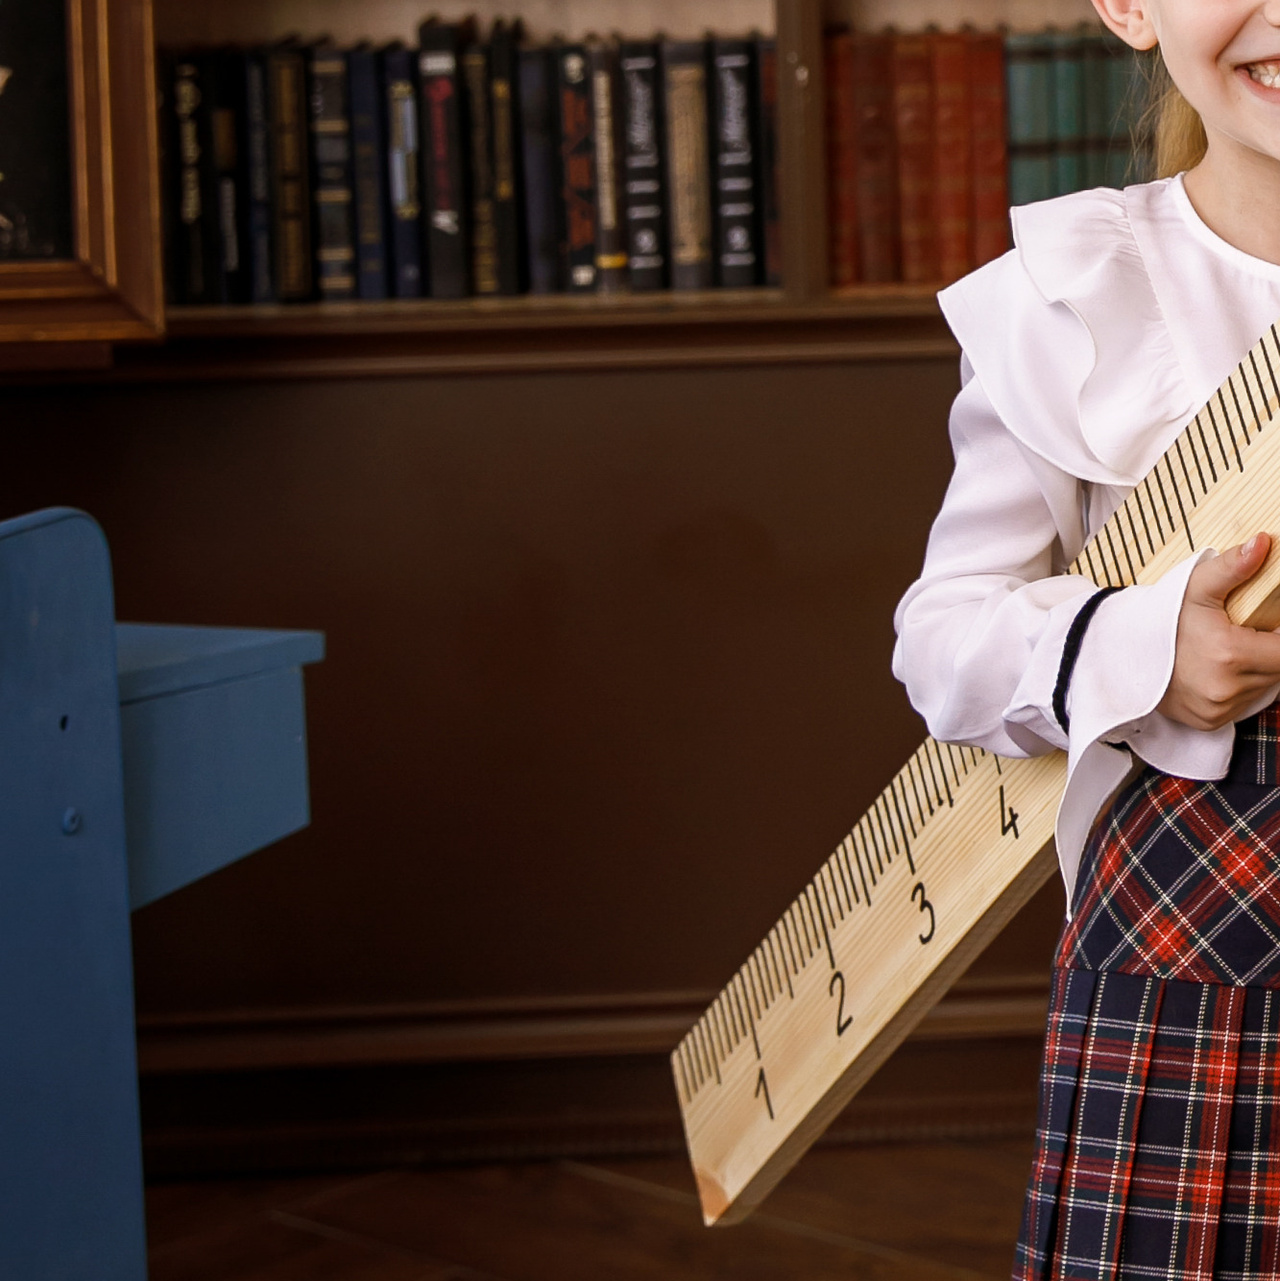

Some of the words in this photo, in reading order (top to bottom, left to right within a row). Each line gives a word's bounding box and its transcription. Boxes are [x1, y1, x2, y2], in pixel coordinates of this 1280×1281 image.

[755, 1067, 774, 1120] 1
[829, 971, 853, 1037] 2
[911, 882, 935, 945] 3
[999, 784, 1019, 839] 4
